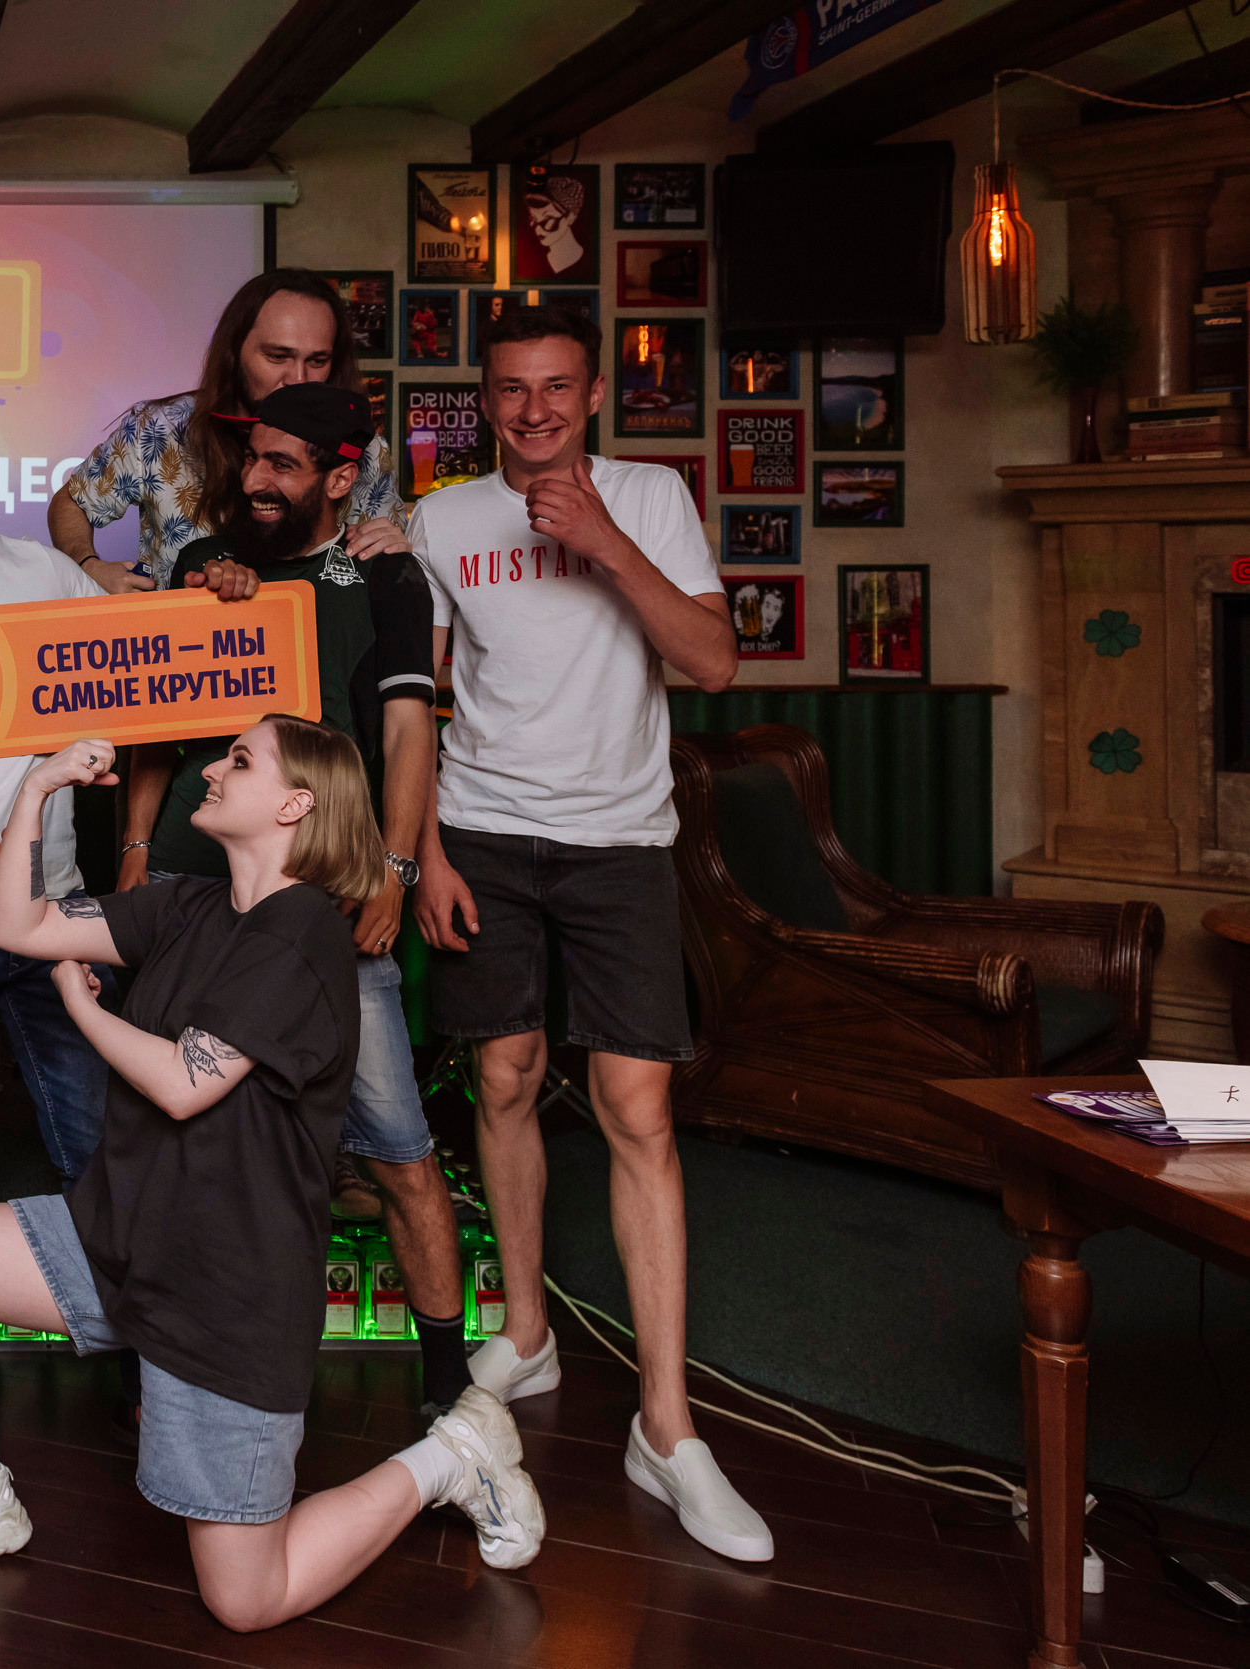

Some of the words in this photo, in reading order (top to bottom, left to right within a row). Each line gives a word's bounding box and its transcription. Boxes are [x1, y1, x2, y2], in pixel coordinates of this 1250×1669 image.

[421, 242, 460, 259] ПИВО
[410, 392, 478, 408] DRINK
[410, 410, 478, 428] GOOD
[728, 417, 793, 429] DRINK
[437, 430, 478, 447] BEER
[728, 430, 794, 443] GOOD
[756, 444, 794, 456] BEER
[753, 465, 795, 476] GOOD
[753, 476, 795, 487] FRIENDS
[36, 633, 171, 674] СЕГОДНЯ
[213, 627, 266, 660] МЫ
[31, 676, 141, 716] САМЫЕ
[149, 665, 277, 705] КРУТЫЕ!
